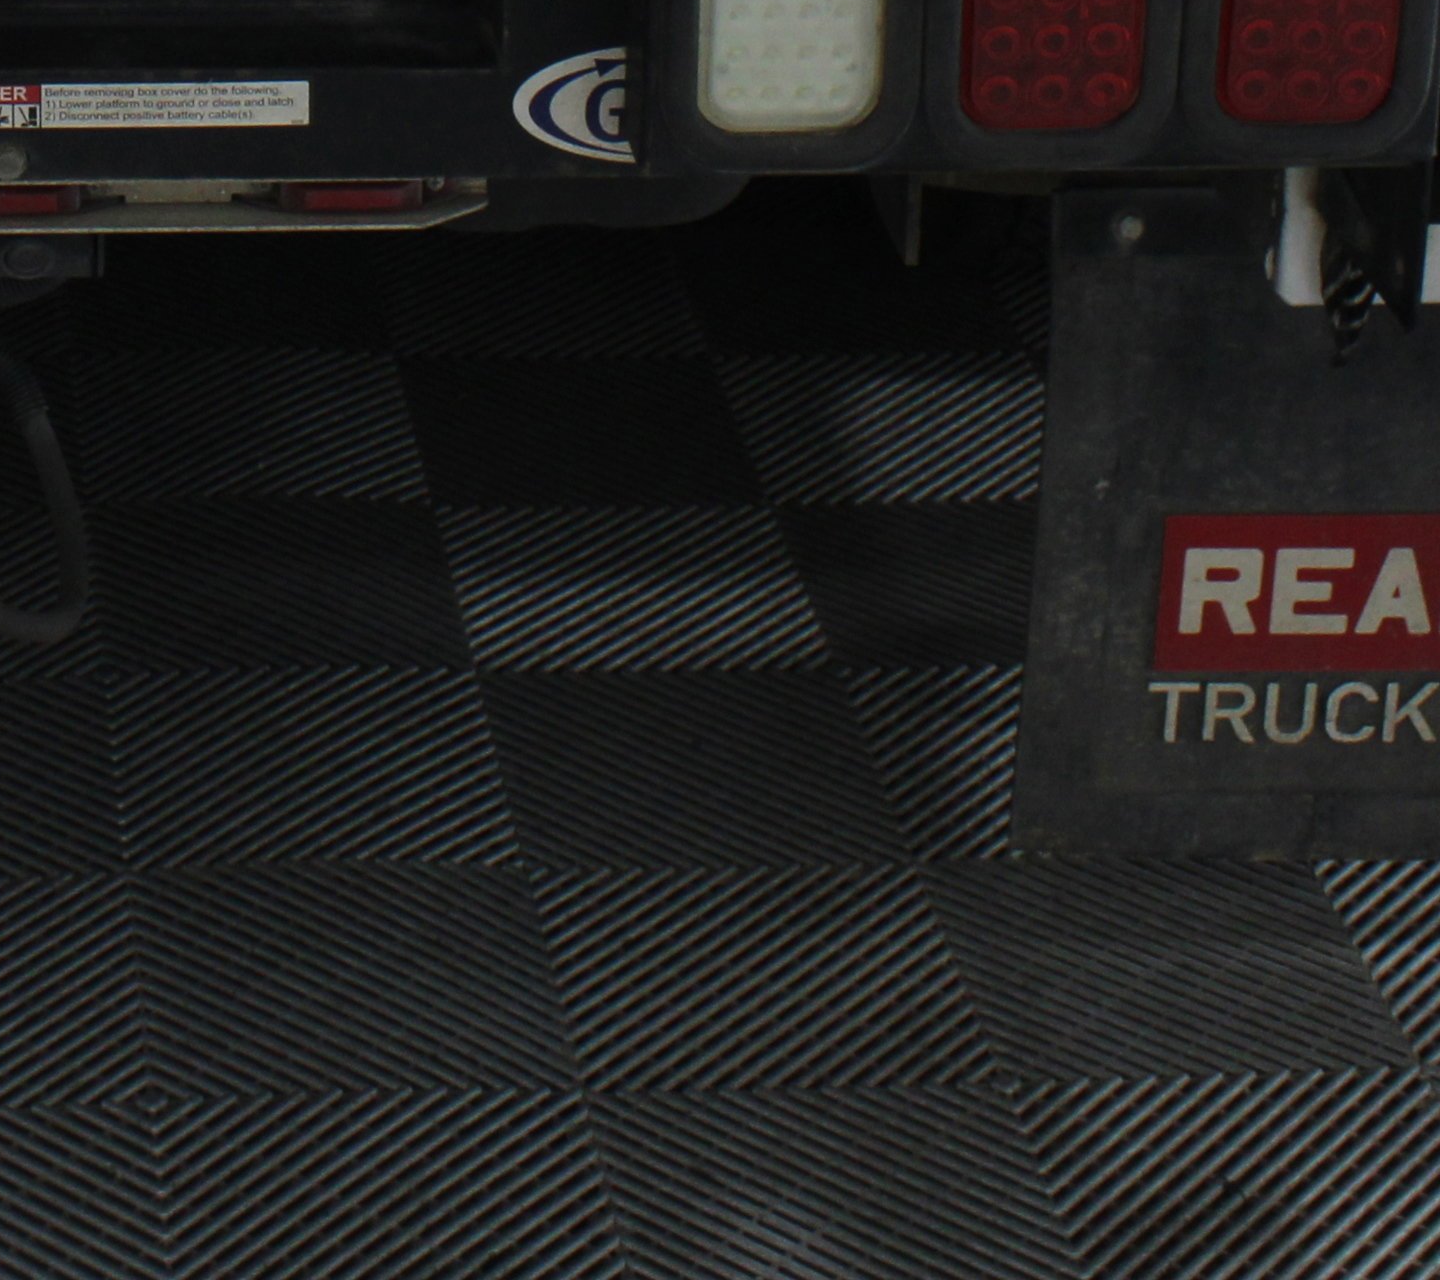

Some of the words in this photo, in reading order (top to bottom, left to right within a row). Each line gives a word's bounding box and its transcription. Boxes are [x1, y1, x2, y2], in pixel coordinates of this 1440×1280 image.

[44, 88, 81, 97] Before
[84, 88, 134, 99] removing
[138, 87, 157, 96] box
[160, 88, 191, 96] cover
[194, 87, 208, 95] do
[211, 86, 228, 95] the
[45, 100, 56, 110] 1)
[58, 100, 93, 109] Lower
[95, 99, 140, 110] platform
[143, 99, 154, 108] to
[156, 99, 195, 110] ground
[198, 100, 209, 108] or
[212, 98, 241, 107] close
[244, 98, 265, 107] and
[44, 111, 56, 122] 2)
[58, 111, 120, 121] Disconnect
[122, 110, 164, 121] positive
[167, 110, 205, 120] battery
[1148, 682, 1438, 744] TRUCK
